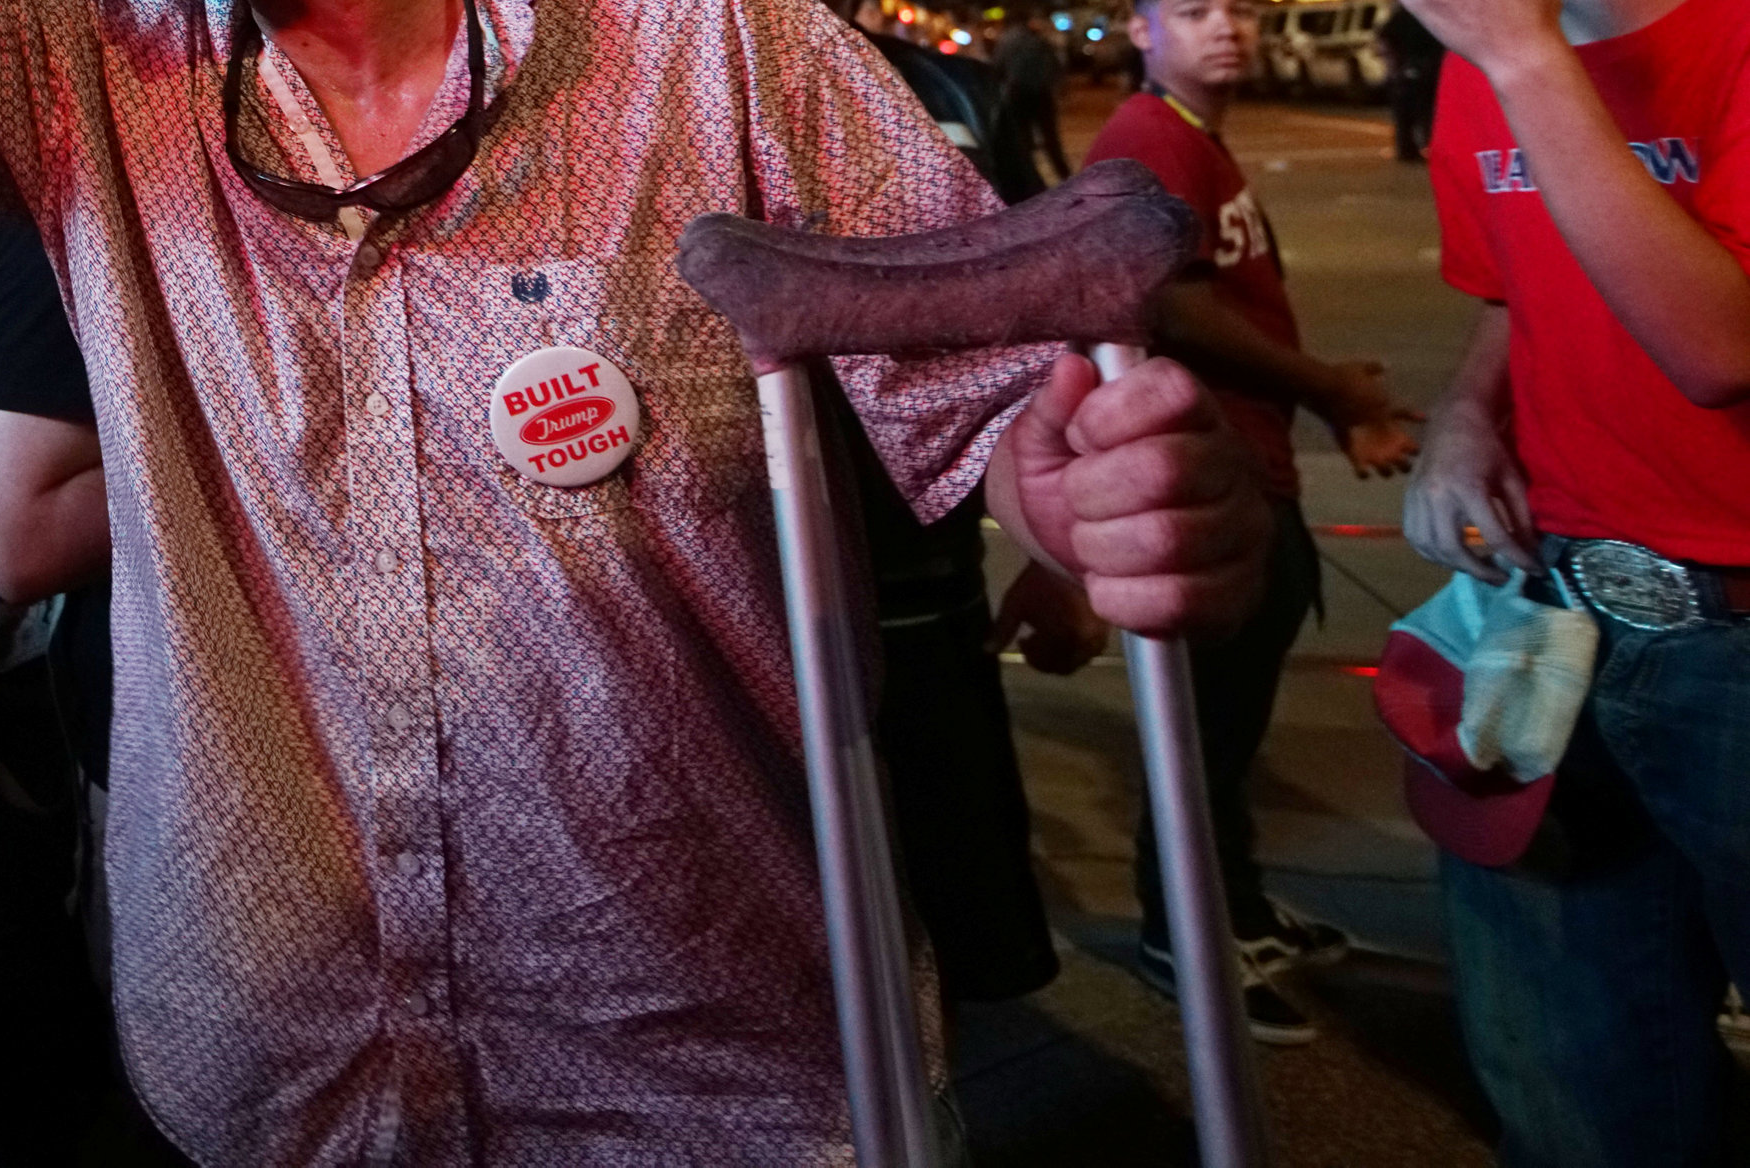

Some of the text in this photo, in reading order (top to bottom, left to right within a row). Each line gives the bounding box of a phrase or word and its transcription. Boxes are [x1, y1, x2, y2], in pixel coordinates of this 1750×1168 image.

[503, 362, 601, 416] BUILT
[535, 406, 599, 441] Trump
[528, 425, 630, 473] TOUGH
